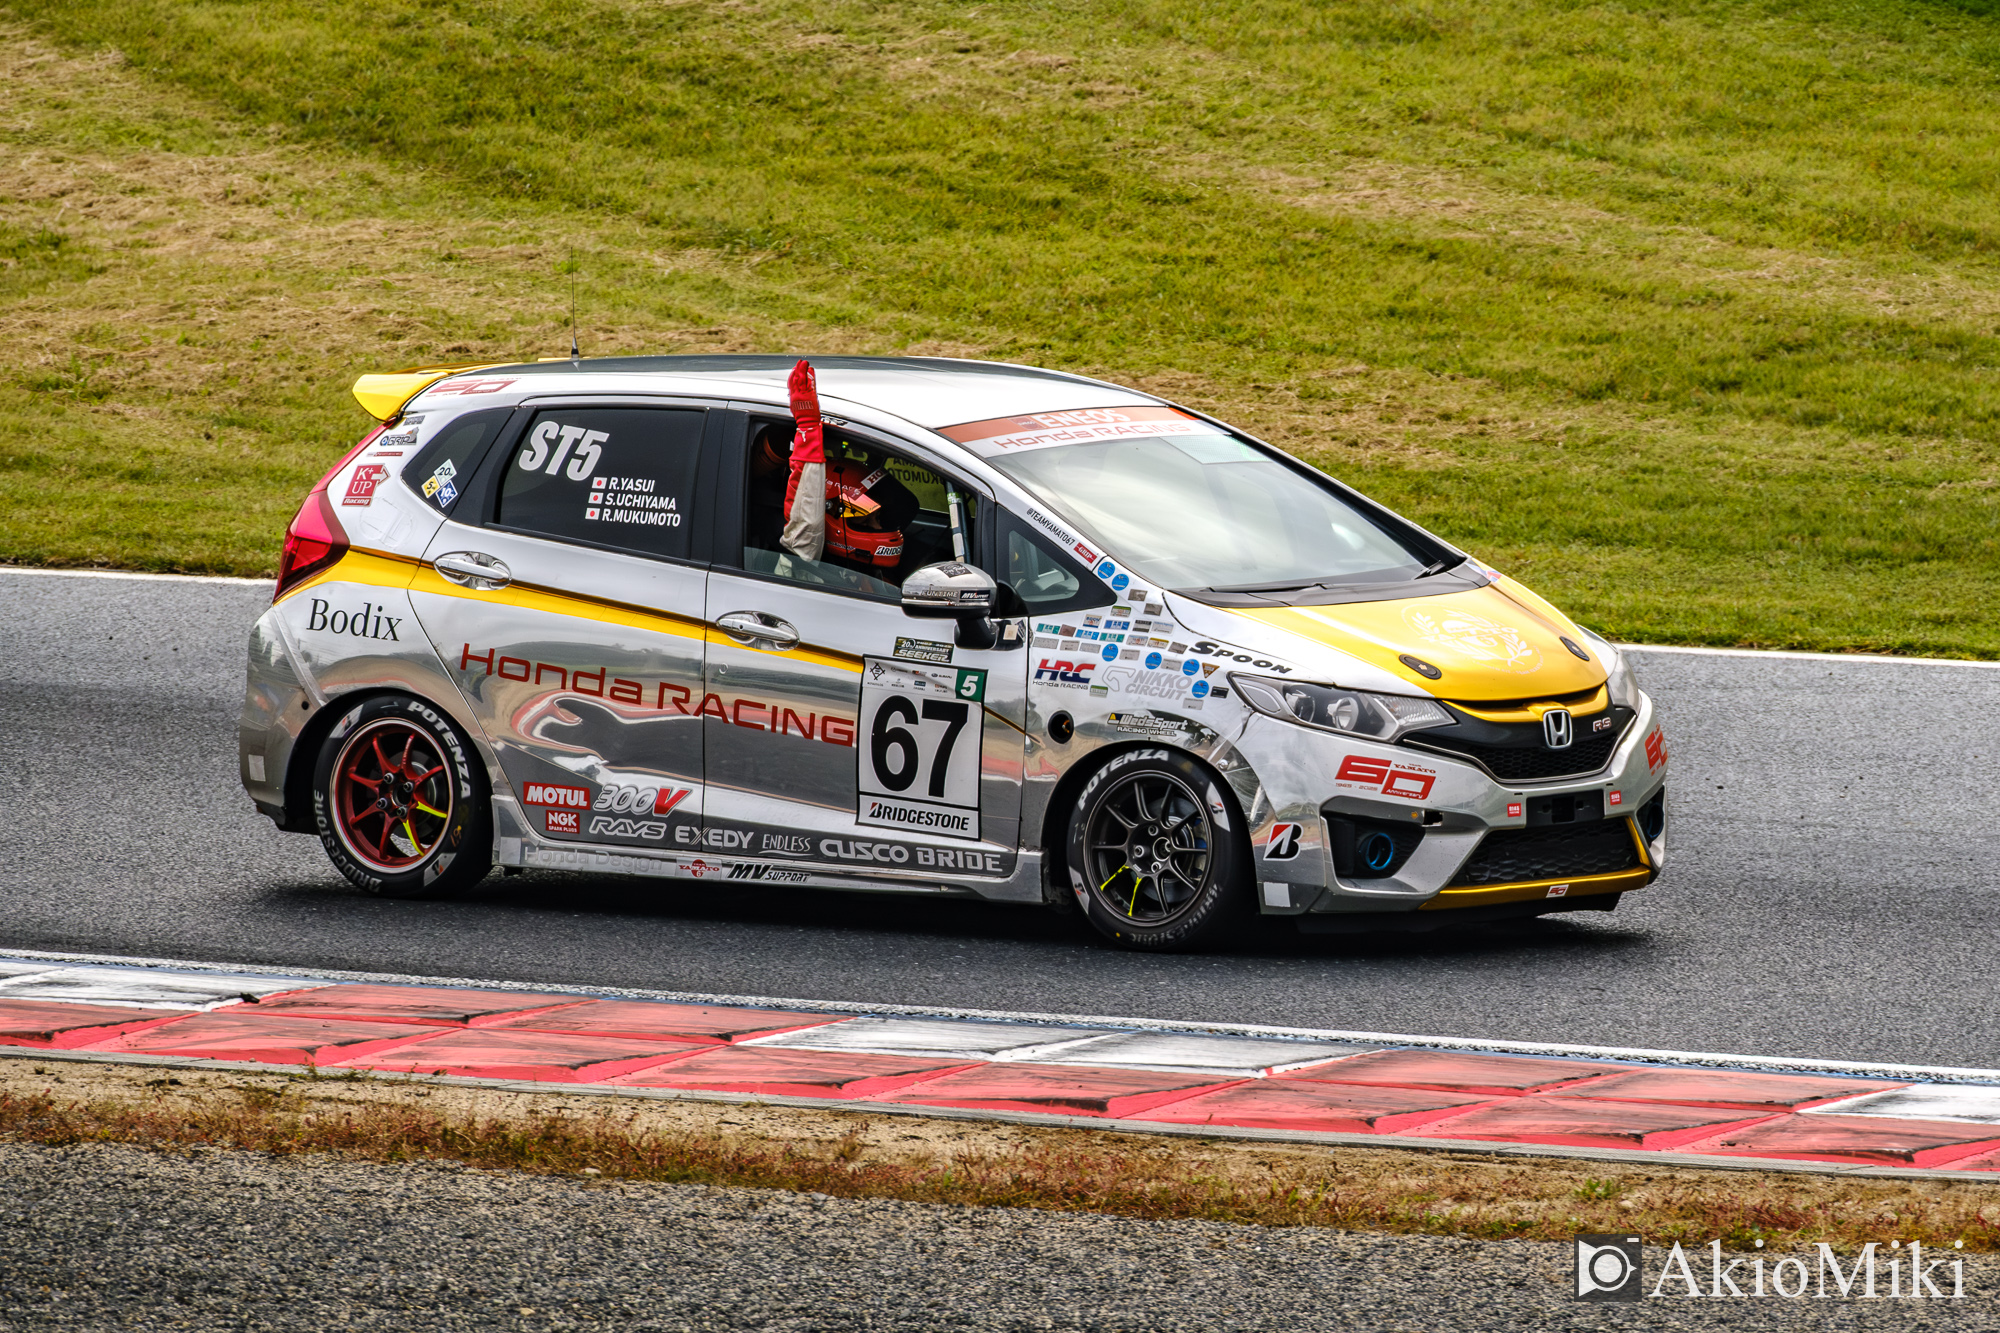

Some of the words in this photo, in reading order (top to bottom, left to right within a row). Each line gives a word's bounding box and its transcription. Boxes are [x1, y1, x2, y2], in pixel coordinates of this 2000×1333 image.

[1031, 409, 1131, 429] ENEOS
[993, 430, 1094, 449] Honda
[1092, 423, 1191, 436] RACING
[518, 421, 610, 481] ST5
[351, 481, 373, 494] UP
[608, 477, 655, 492] R.YASUI
[605, 492, 677, 510] S.UCHIYAMA
[602, 508, 681, 527] R.MUKUMOTO
[1026, 507, 1075, 546] @TEAMYAMATO67
[306, 598, 402, 642] Bodix
[895, 649, 949, 662] SEEKER
[1034, 658, 1096, 684] HRC
[1133, 670, 1192, 690] NIKKO
[460, 643, 642, 705] Honda
[657, 681, 855, 747] RACING
[960, 675, 979, 697] 5
[1033, 680, 1059, 688] Honda
[1125, 683, 1187, 700] CIRCUIT
[1117, 726, 1146, 734] RACING
[1149, 729, 1176, 737] WHEEL
[1118, 714, 1188, 730] WedsSport
[1593, 717, 1612, 732] RS
[407, 701, 471, 799] POTENZA
[871, 695, 968, 798] 67
[1335, 754, 1436, 800] 60
[1393, 763, 1436, 774] YAMATO
[1077, 749, 1169, 811] POTENZA
[526, 785, 588, 807] MOTUL
[593, 783, 693, 818] 300V
[1386, 788, 1423, 799] Anniversary
[548, 812, 577, 827] NGK
[869, 802, 970, 830] BRIDGESTONE
[589, 816, 666, 839] RAYS
[674, 825, 754, 849] EXEDY
[313, 789, 383, 893] BRIDGESTONE
[762, 834, 811, 851] ENDLESS
[819, 838, 909, 863] CUSCO
[524, 847, 589, 865] Honda
[915, 846, 1003, 872] BRIDE
[727, 863, 773, 879] MV
[765, 871, 812, 883] SUPPORT
